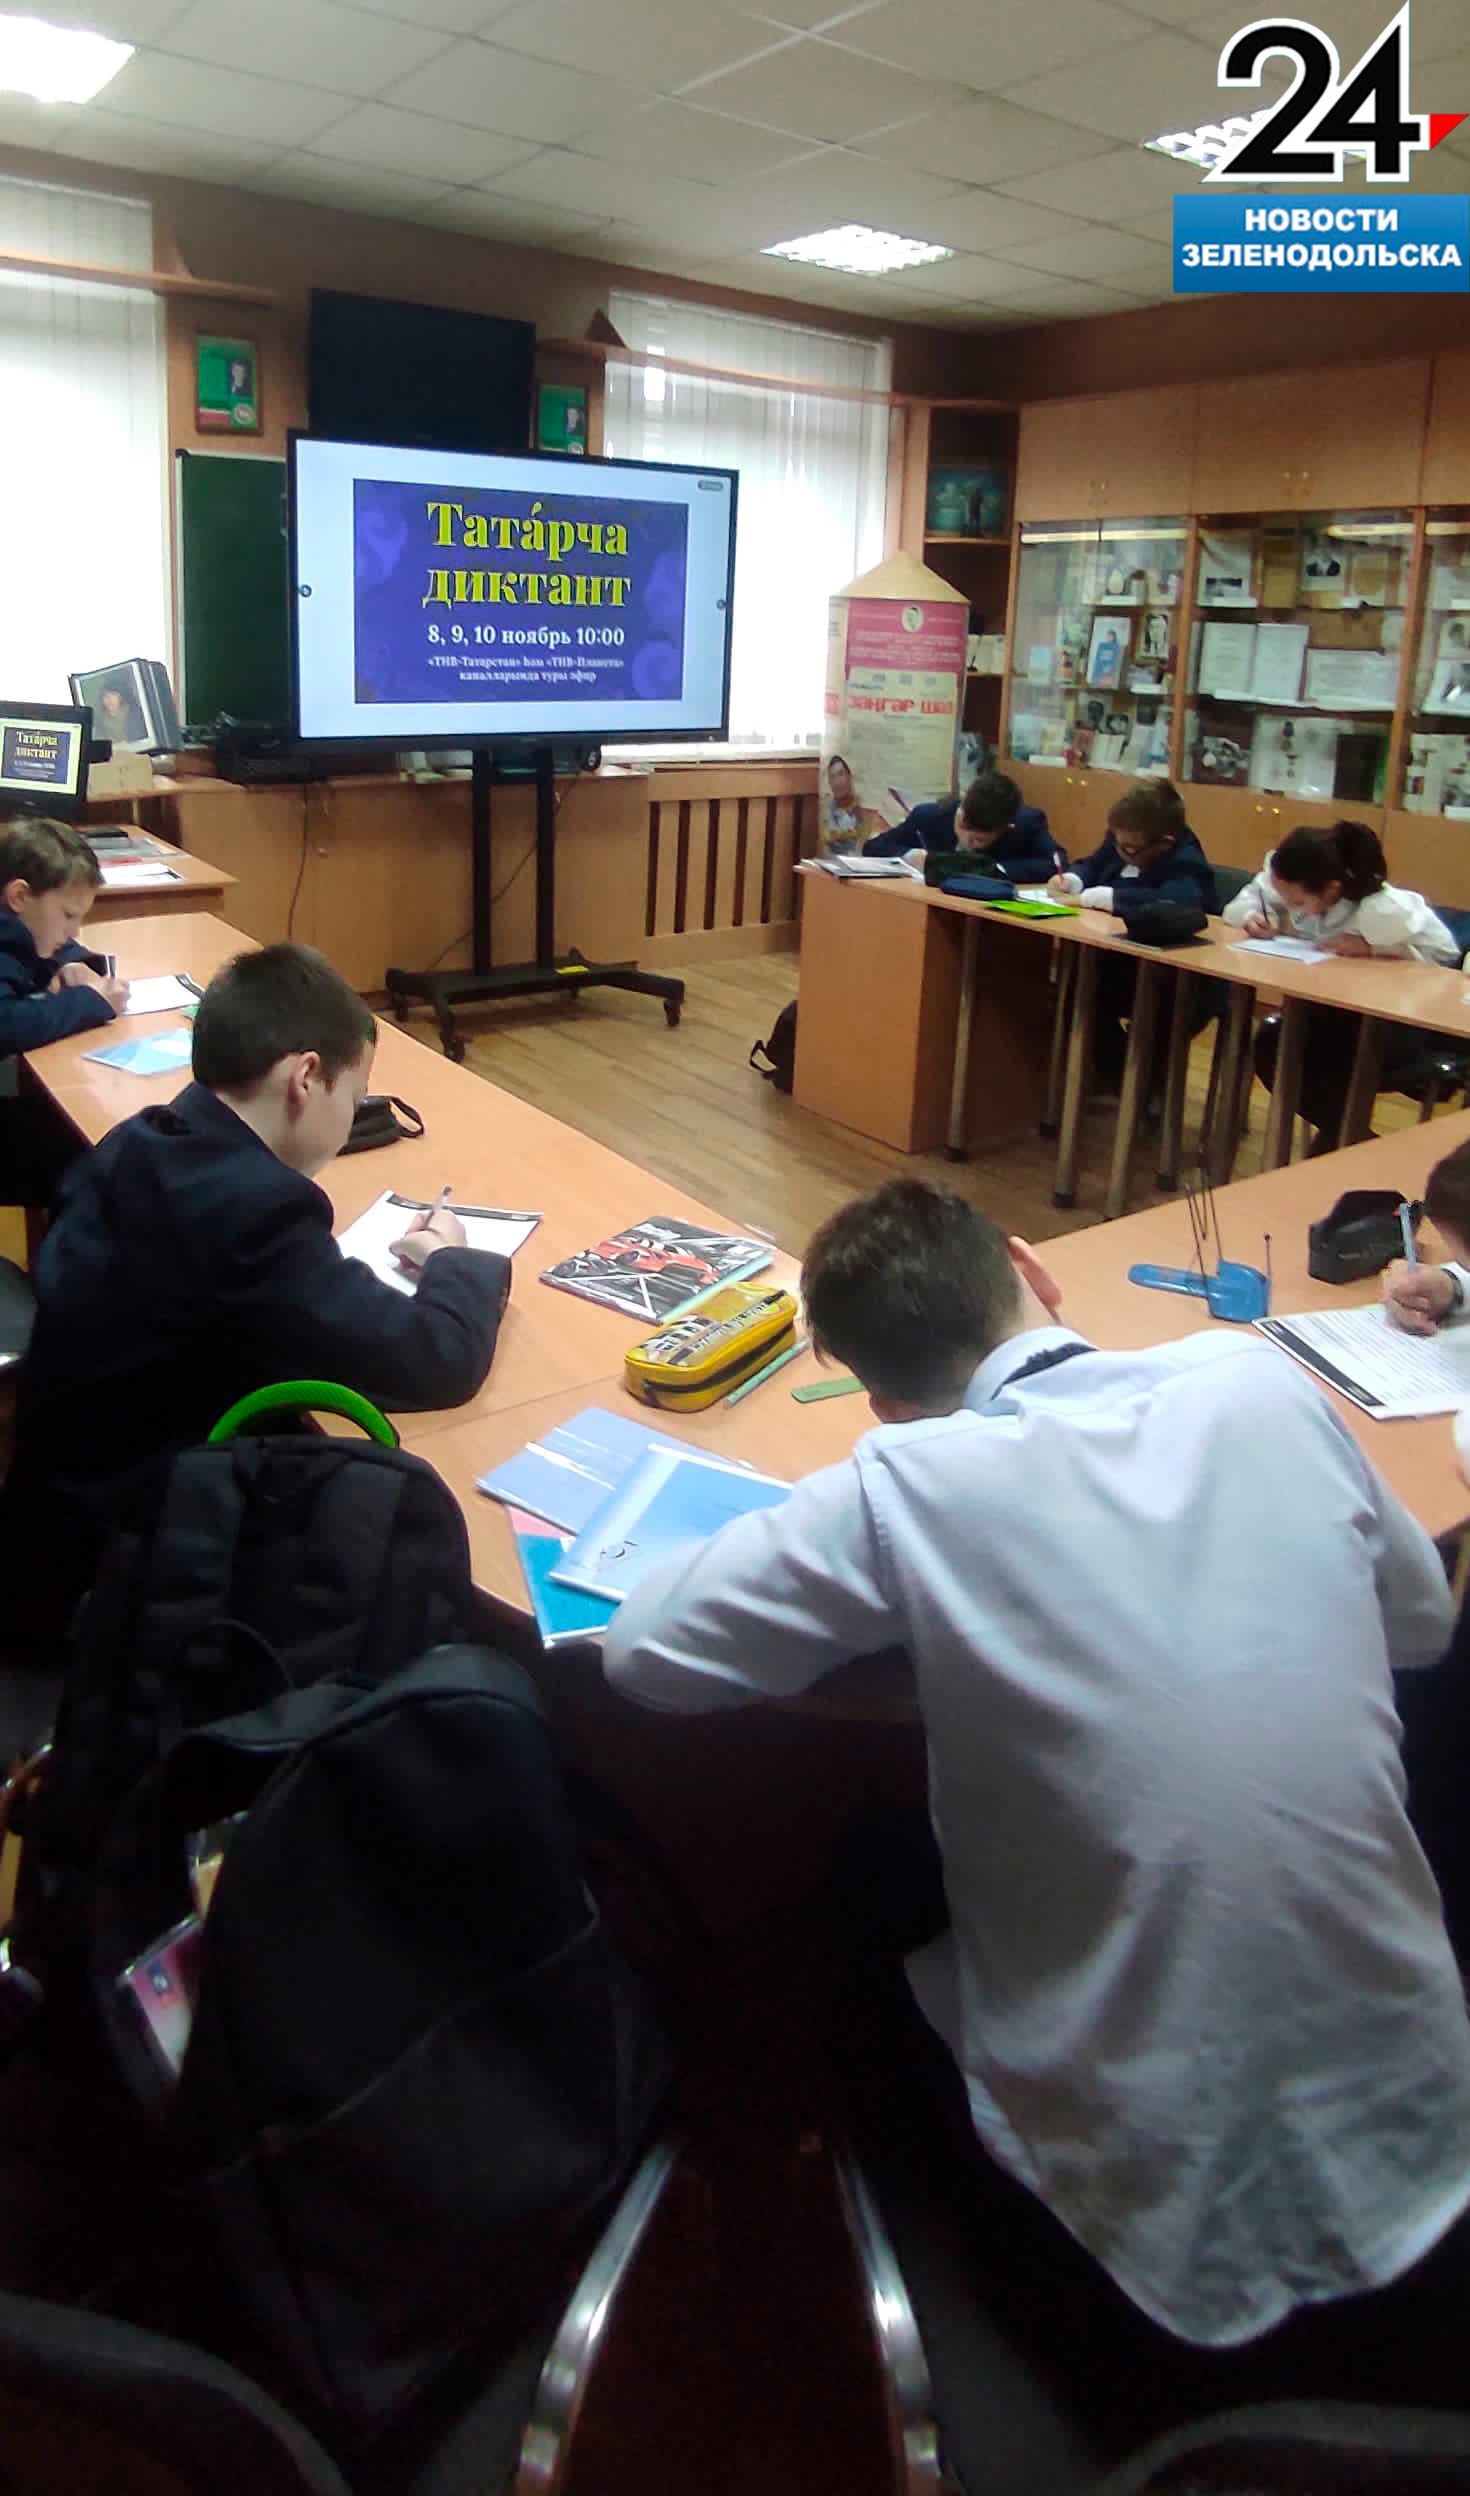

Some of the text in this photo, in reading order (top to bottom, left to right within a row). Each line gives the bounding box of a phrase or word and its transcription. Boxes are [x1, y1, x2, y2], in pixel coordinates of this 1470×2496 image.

[421, 568, 632, 609] диктант
[427, 624, 625, 650] 8, 9, 10 ноябрь 10:00
